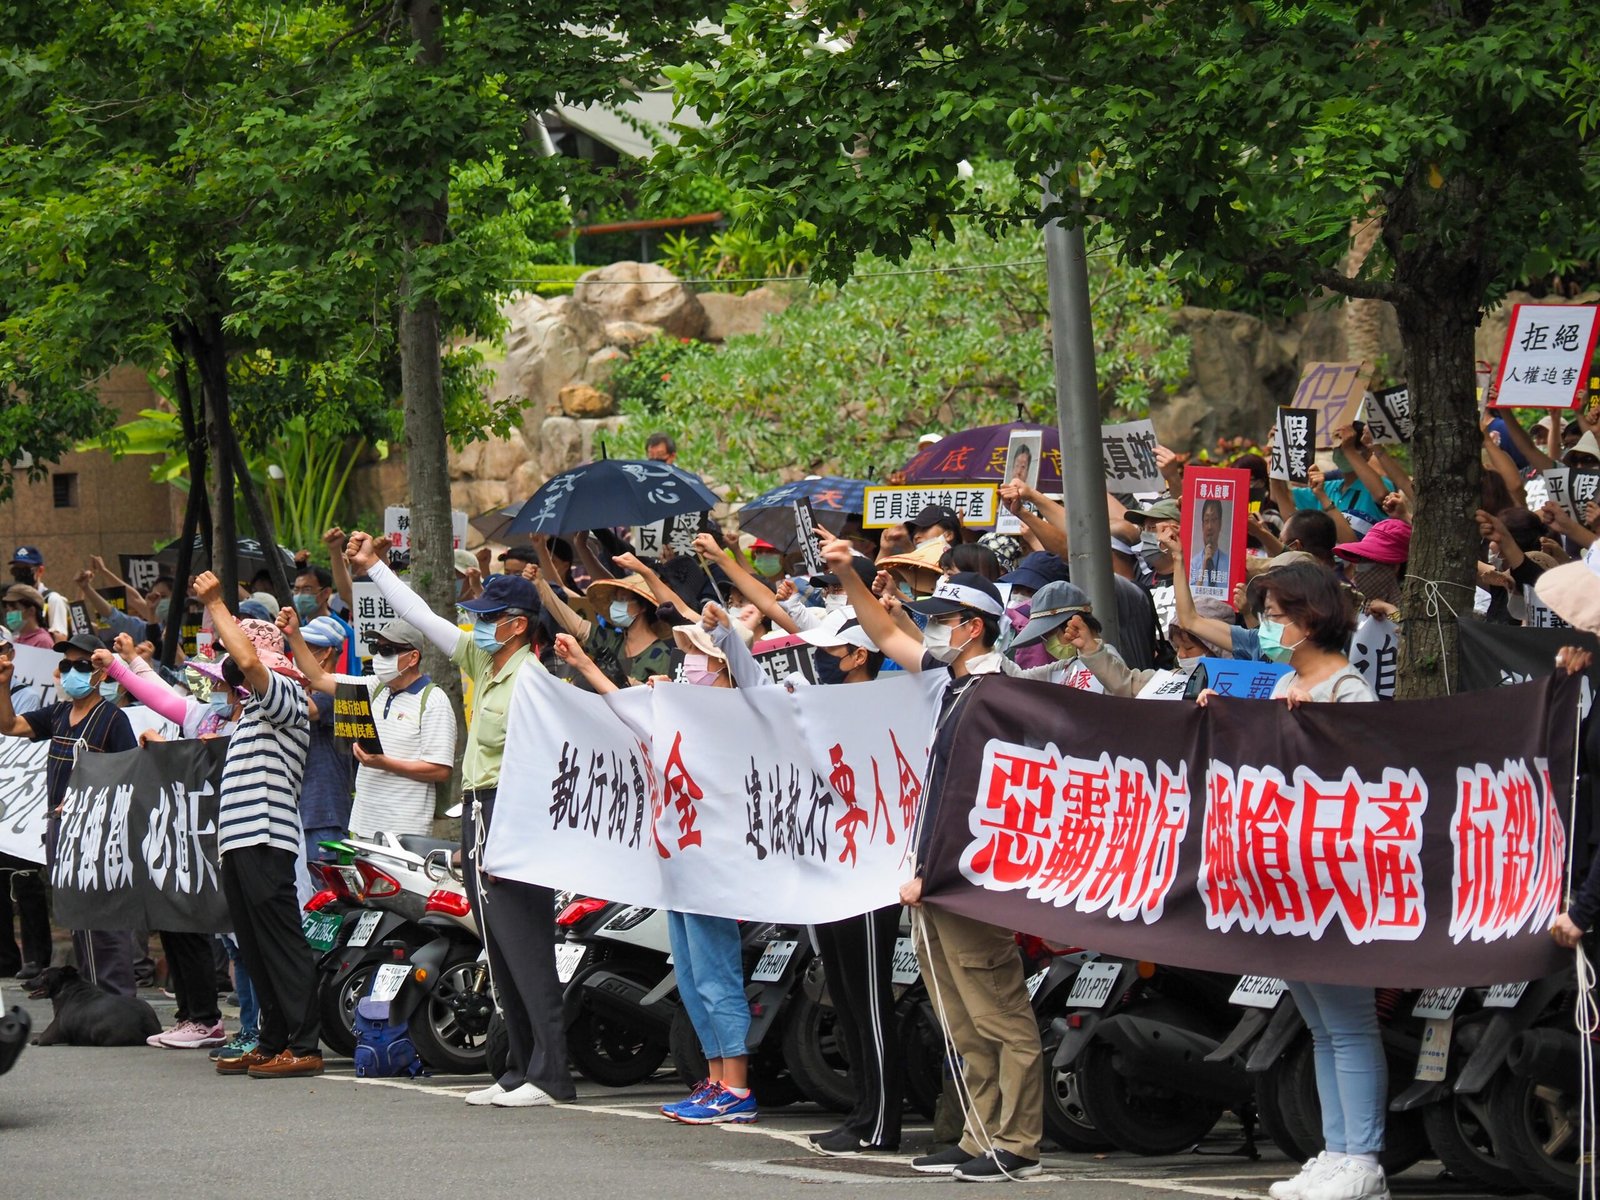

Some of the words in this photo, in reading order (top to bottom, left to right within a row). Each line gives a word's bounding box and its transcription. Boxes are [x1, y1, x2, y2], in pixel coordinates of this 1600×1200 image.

[1520, 322, 1580, 352] 拒絕
[1505, 366, 1578, 385] 人權迫害
[1284, 415, 1308, 478] 假案
[872, 490, 985, 520] 官員違法搶民產
[938, 586, 961, 599] 平反
[1153, 680, 1186, 695] 迫害
[962, 742, 1189, 920] 惡霸執行
[1200, 763, 1425, 940] 強搶民產
